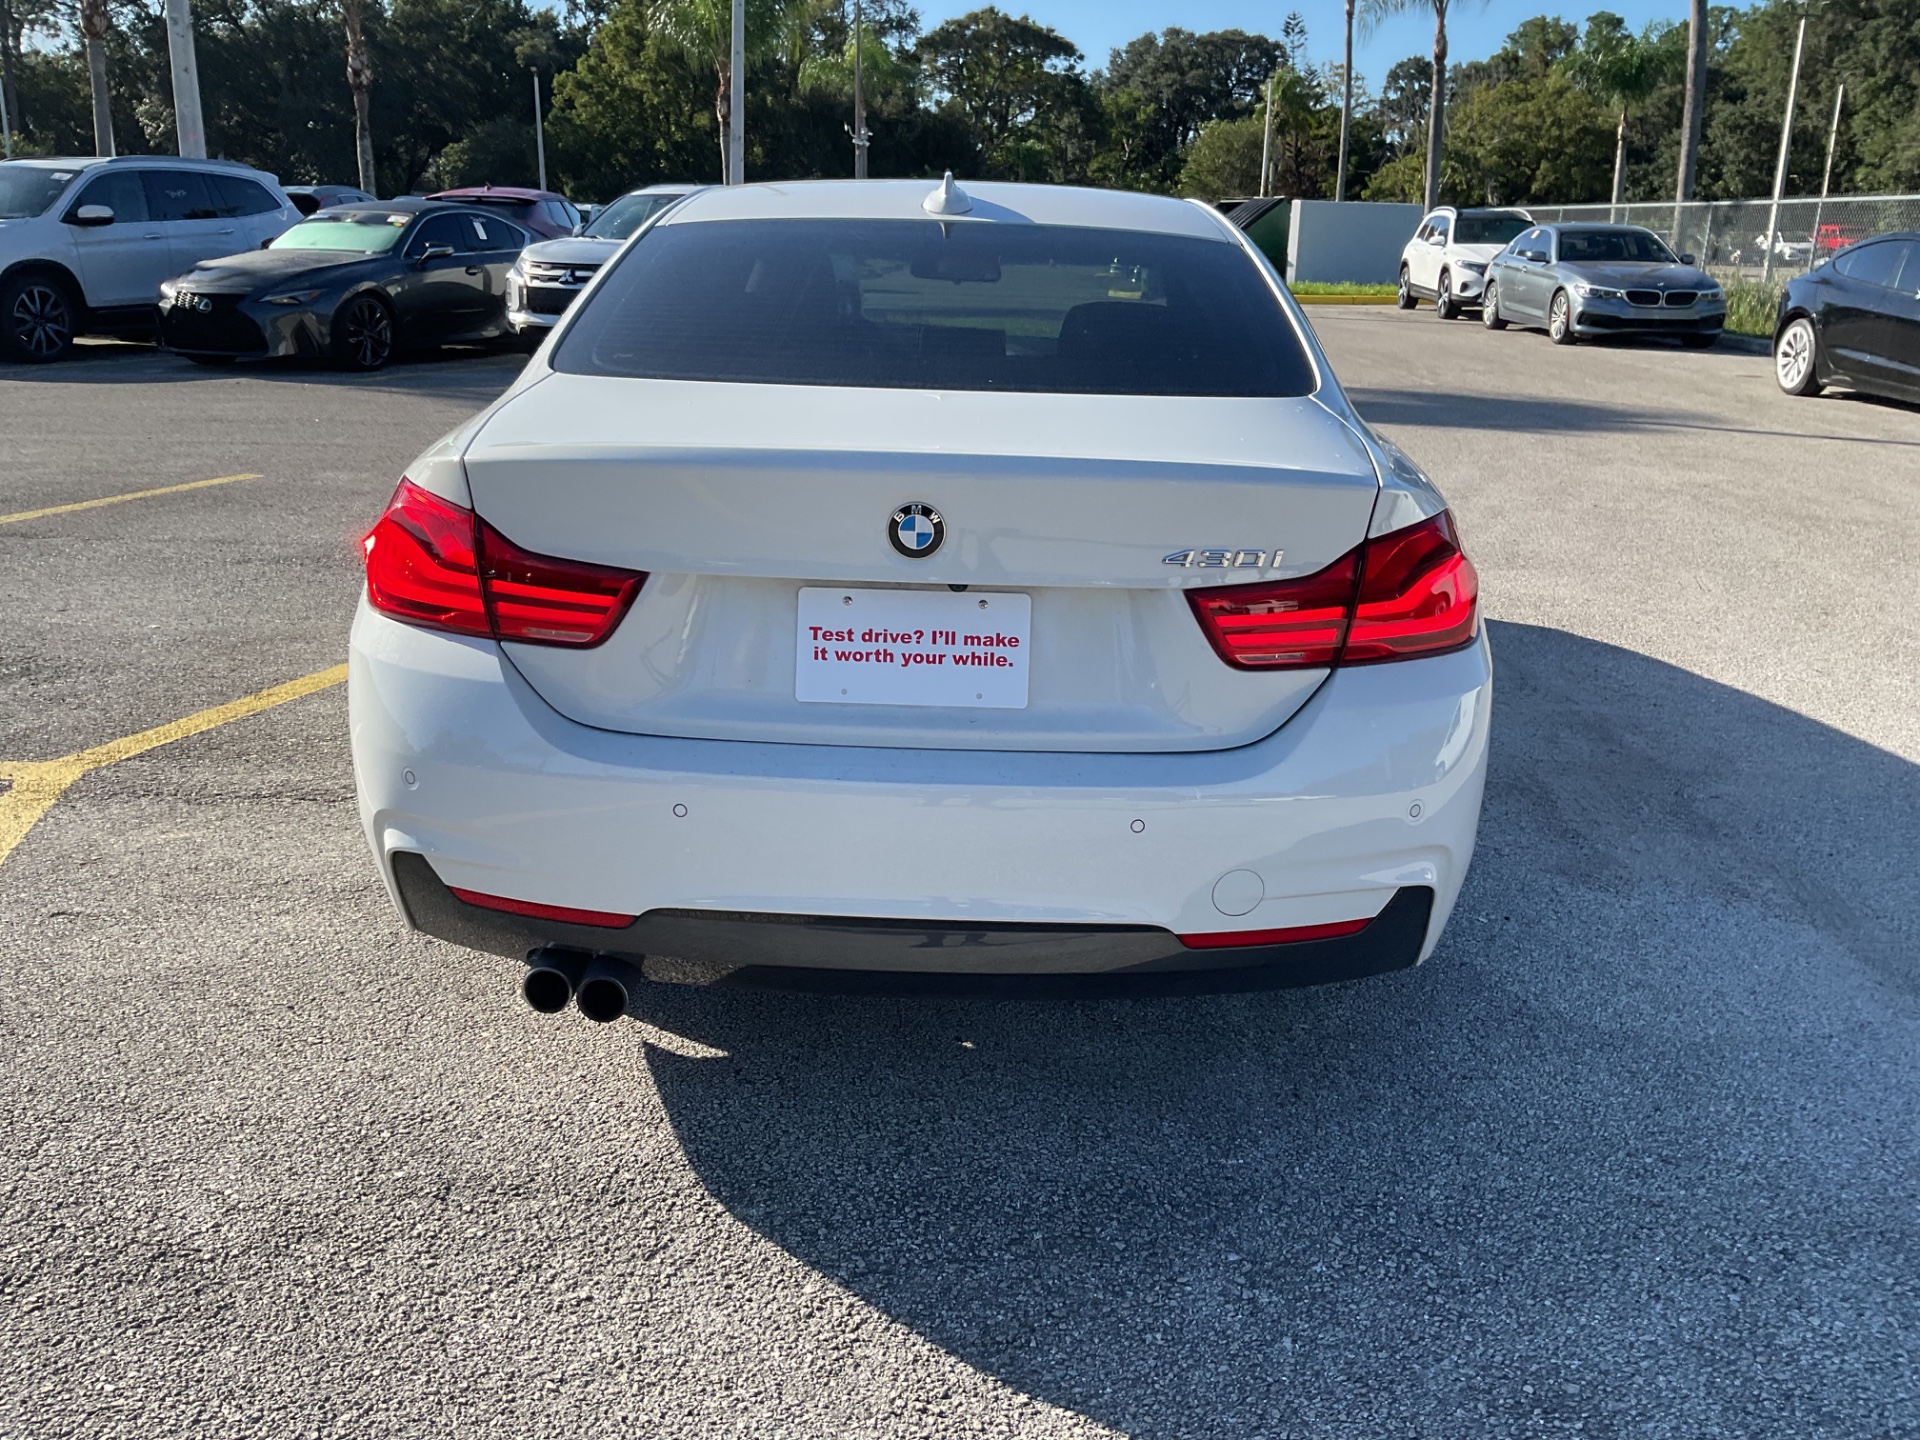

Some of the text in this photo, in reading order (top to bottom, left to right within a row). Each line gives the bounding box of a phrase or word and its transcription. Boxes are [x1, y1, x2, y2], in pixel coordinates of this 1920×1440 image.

[893, 505, 941, 524] BMW
[1162, 548, 1284, 568] 430i
[808, 626, 1020, 648] Test drive? I'll make
[813, 646, 1014, 668] it worth your while.
